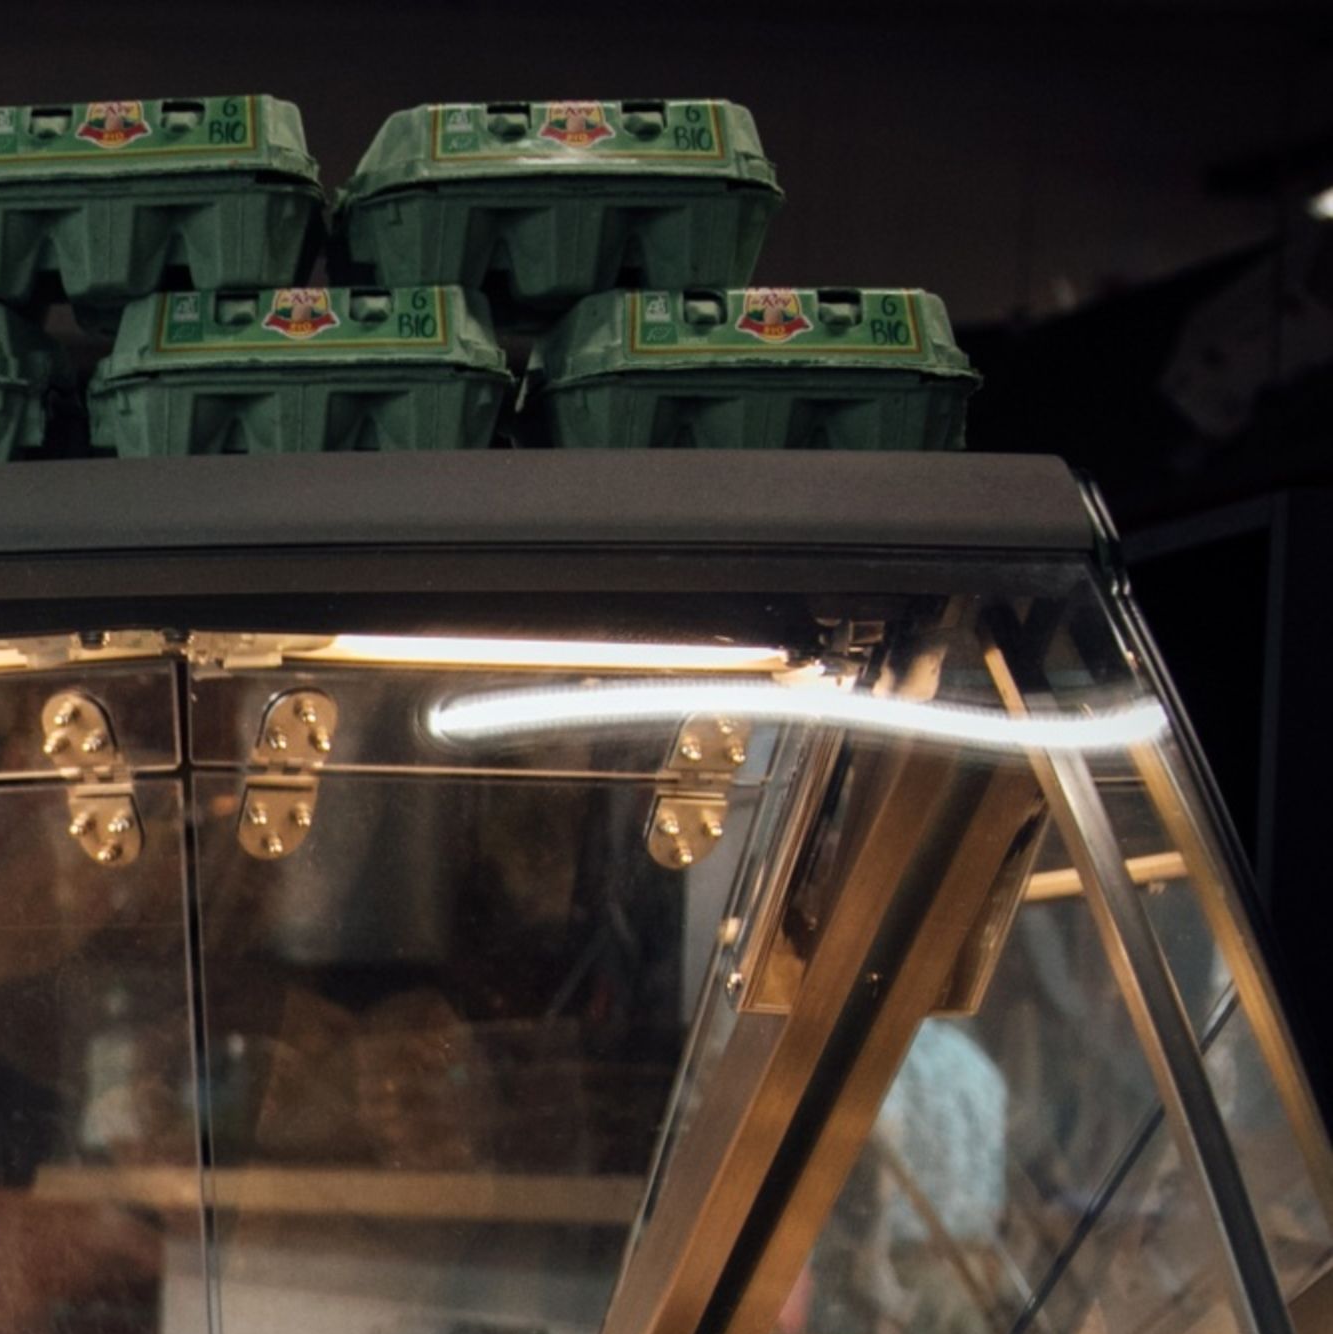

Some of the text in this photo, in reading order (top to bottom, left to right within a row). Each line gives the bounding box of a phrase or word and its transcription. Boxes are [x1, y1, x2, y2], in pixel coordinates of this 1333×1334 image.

[223, 97, 238, 117] 6
[685, 104, 701, 122] 6
[208, 121, 247, 145] BIO
[673, 126, 713, 151] BIO
[410, 290, 427, 310] 6
[881, 296, 897, 316] 6
[398, 313, 437, 339] BIO
[870, 319, 909, 346] BIO
